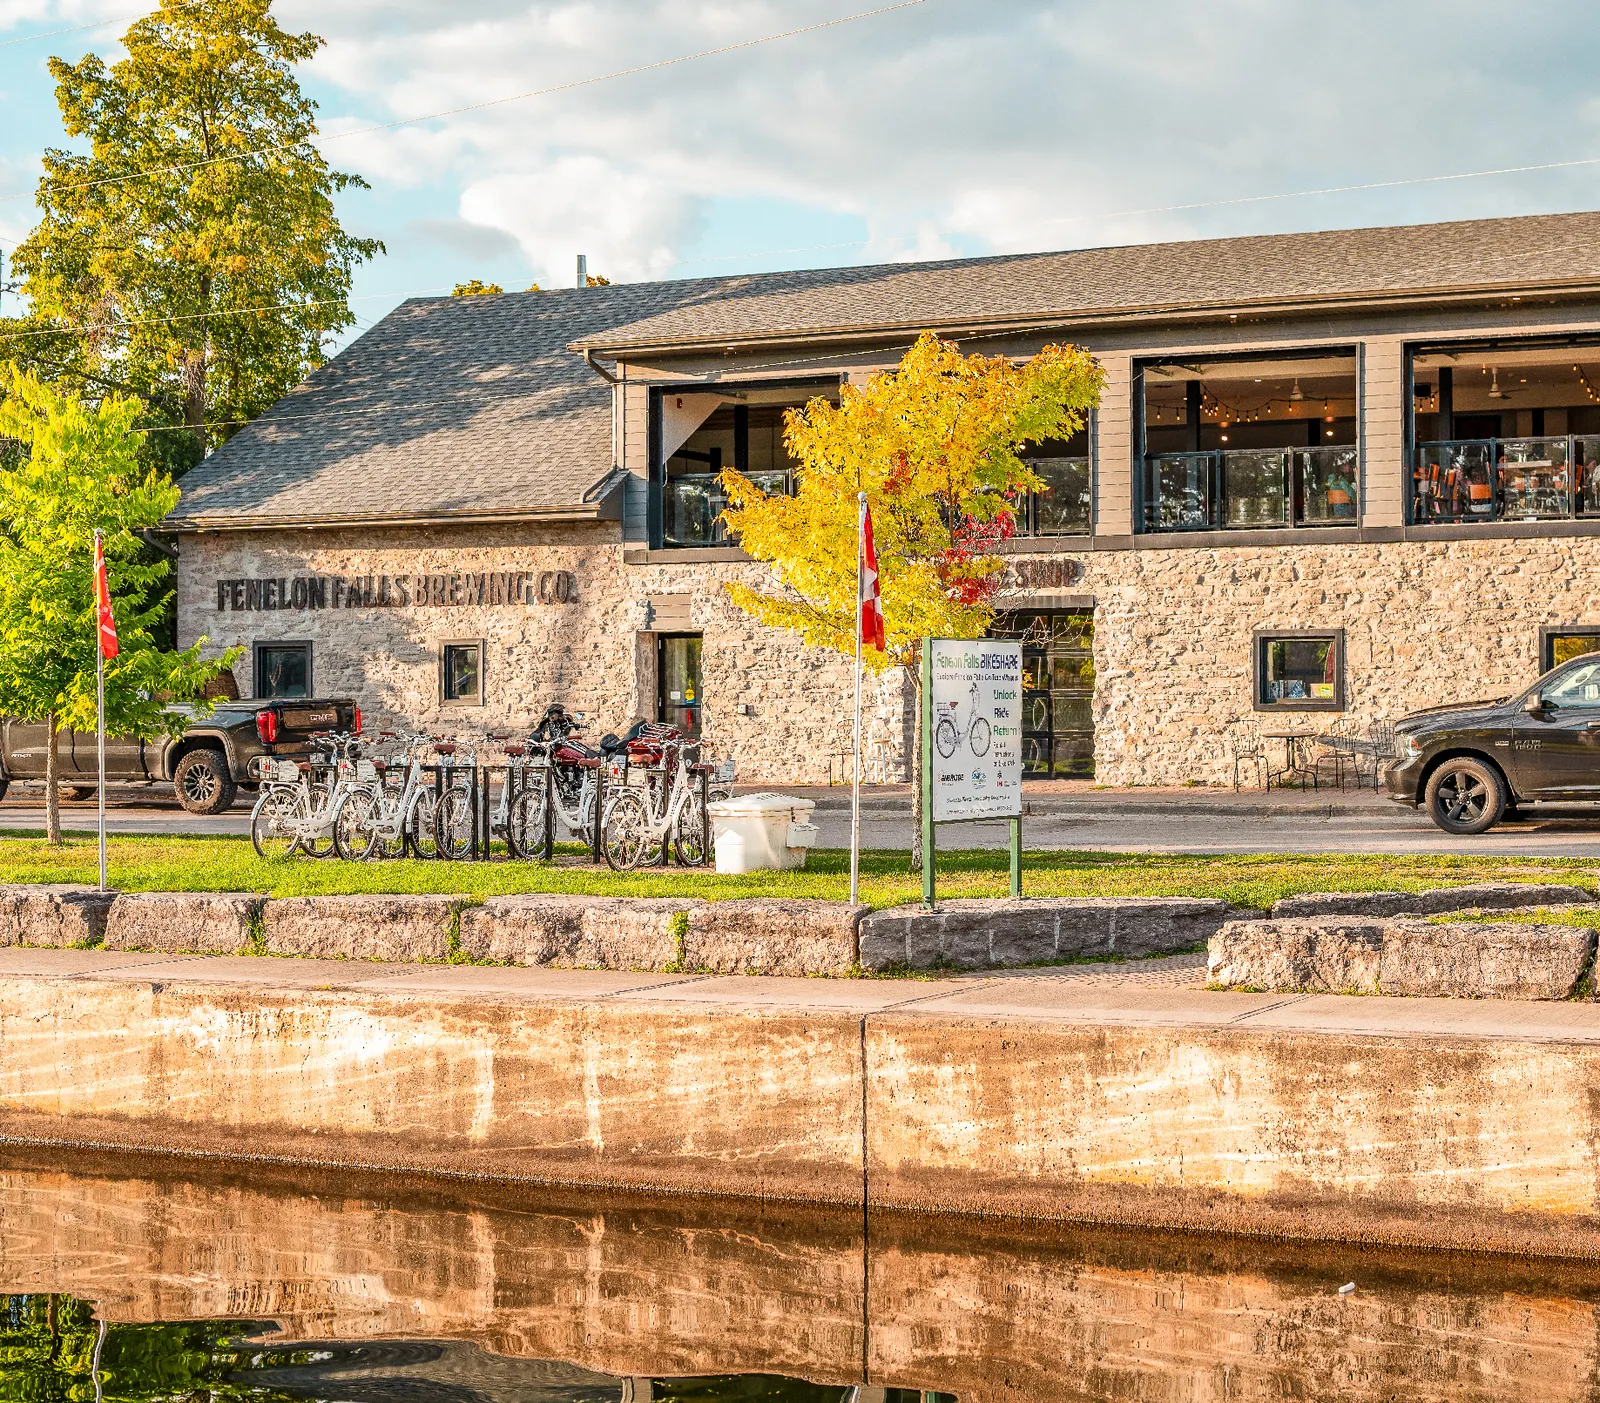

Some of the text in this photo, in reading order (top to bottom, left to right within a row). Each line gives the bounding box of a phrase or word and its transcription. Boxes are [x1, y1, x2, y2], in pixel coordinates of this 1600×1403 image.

[217, 578, 325, 611] FENELON
[332, 574, 409, 608] FALLS
[412, 571, 530, 608] BREWING
[963, 652, 980, 669] Falls
[980, 653, 1018, 669] BIKESHARE
[993, 689, 1017, 700] Unlock
[994, 708, 1009, 718] Ride
[993, 725, 1017, 736] Return
